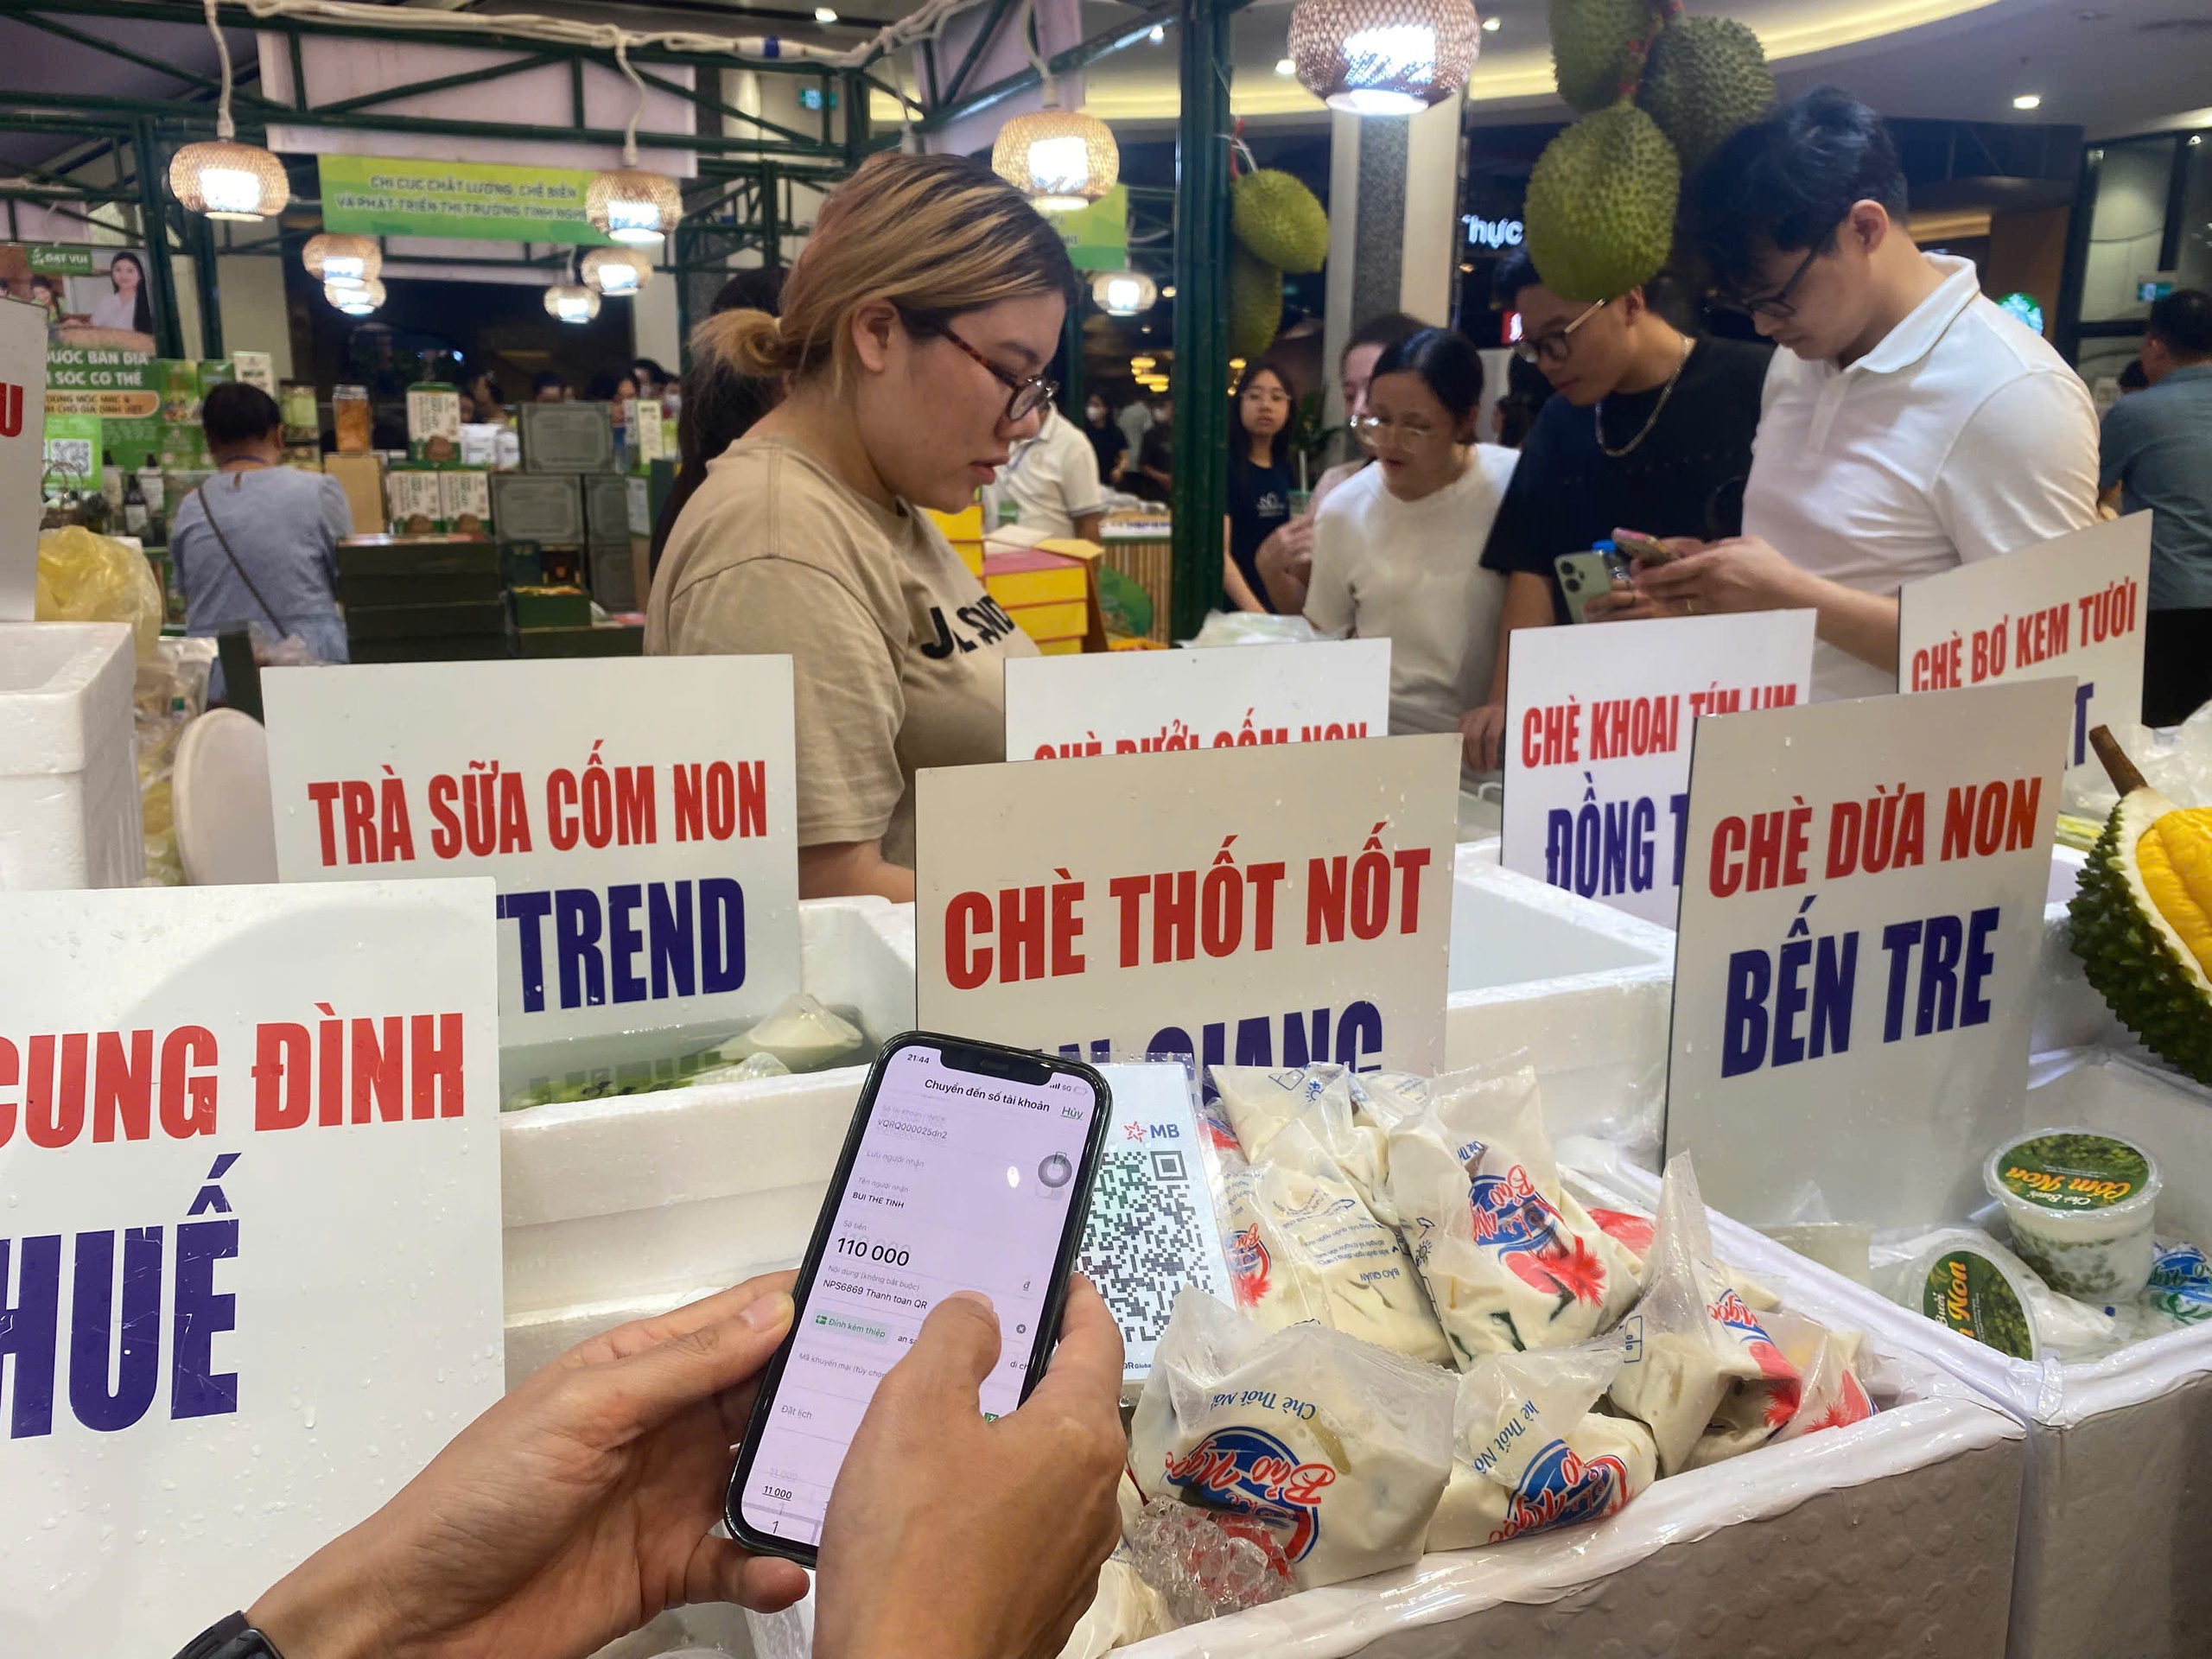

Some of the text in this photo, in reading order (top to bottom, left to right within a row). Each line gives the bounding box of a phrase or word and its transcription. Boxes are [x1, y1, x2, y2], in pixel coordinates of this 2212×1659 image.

[1911, 576, 2137, 692] CHÈ BƠ KEM TƯƠI
[1522, 695, 1580, 768] CHÈ
[1590, 695, 1680, 760] KHOAI
[308, 740, 767, 867] TRÀ SỮA CỐM NON
[1545, 771, 1656, 899] ĐỒNG
[1708, 777, 2042, 899] CHÈ DỪA NON
[944, 821, 1432, 990] CHÈ THỐT NỐT
[512, 877, 746, 1014] TREND
[1720, 894, 2000, 1078] BẾN TRE
[251, 1002, 464, 1132] ĐÌNH
[907, 1053, 930, 1065] 21:44
[925, 1078, 1050, 1112] Chuyển đến số tài khoản
[1062, 1107, 1084, 1121] Hủy
[1150, 1123, 1180, 1139] MB
[853, 1192, 905, 1209] BUI THE TINH
[836, 1237, 910, 1267] 110 000
[0, 1152, 242, 1440] HUẾ
[823, 1280, 927, 1310] NPS6869 Thanh toan QR
[1241, 1390, 1276, 1410] Thốt
[1282, 1397, 1316, 1420] Chè
[1474, 1400, 1539, 1474] hè Thốt Nố
[764, 1485, 792, 1500] 11 000
[1251, 1455, 1336, 1504] Bảo
